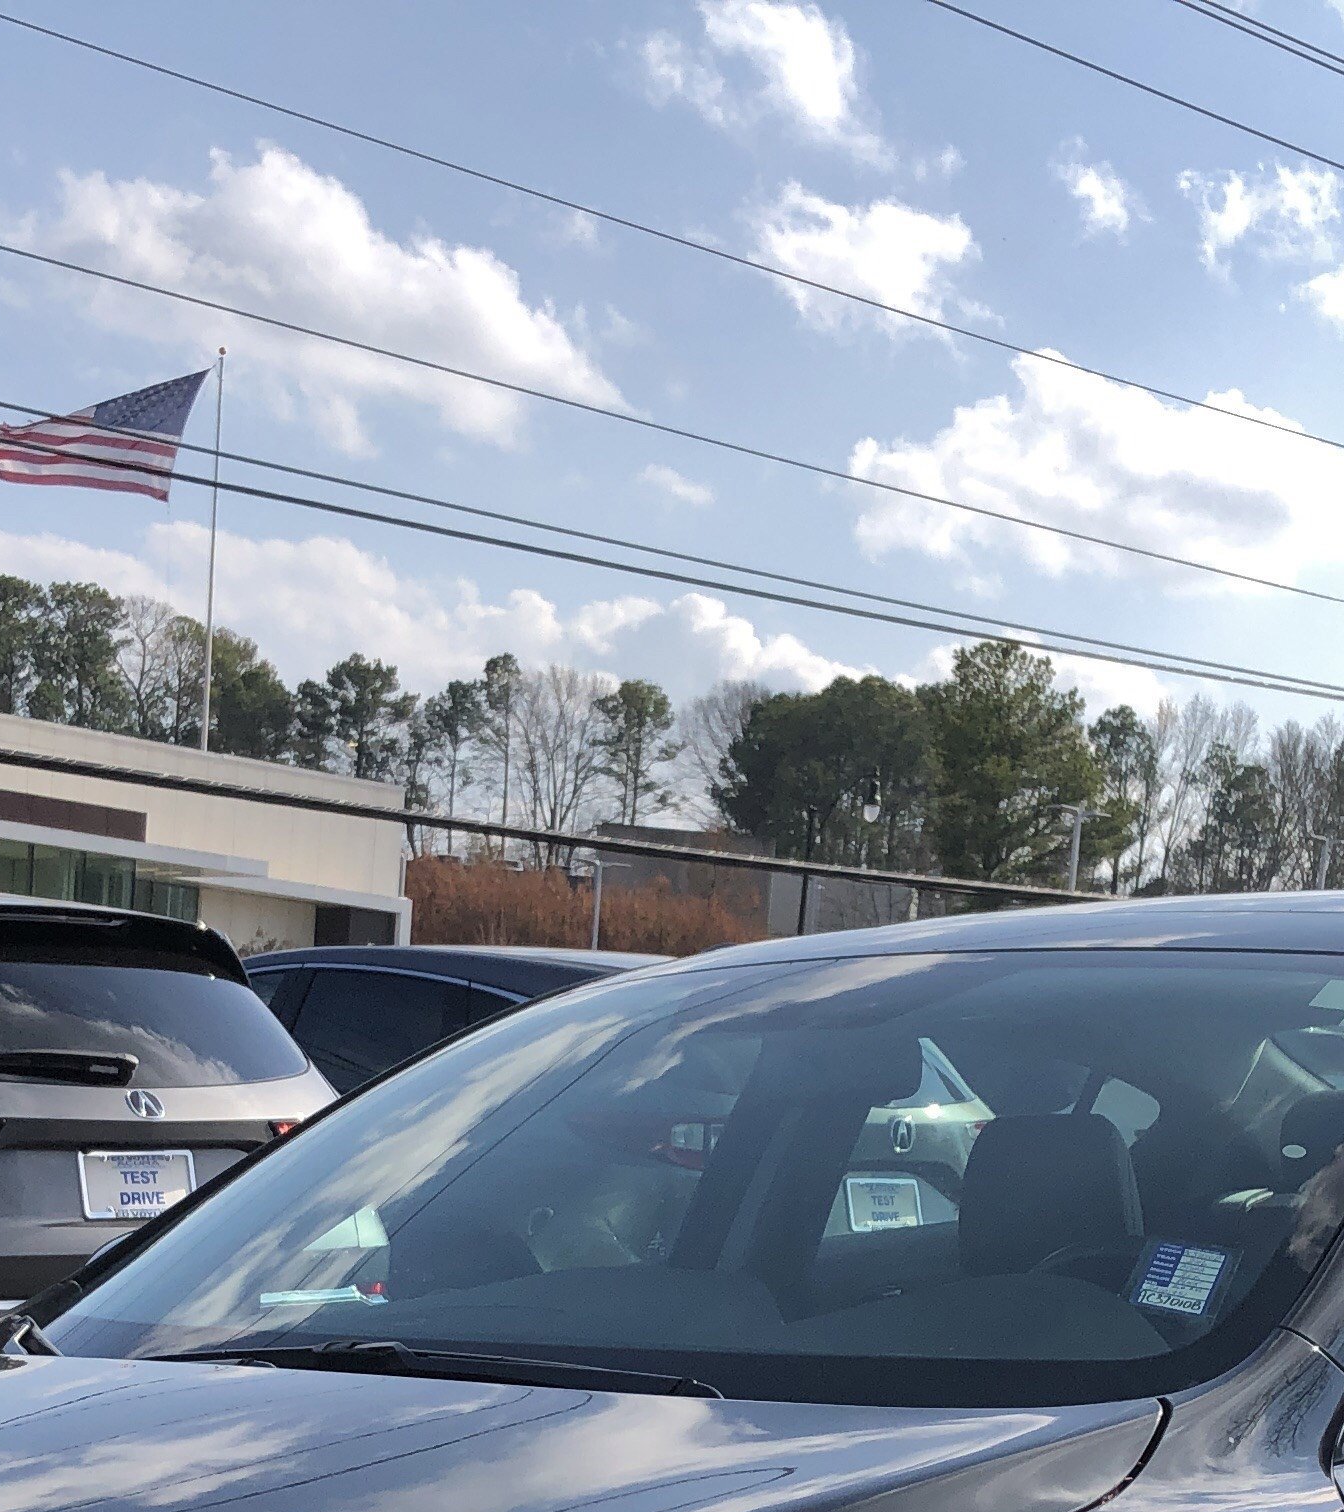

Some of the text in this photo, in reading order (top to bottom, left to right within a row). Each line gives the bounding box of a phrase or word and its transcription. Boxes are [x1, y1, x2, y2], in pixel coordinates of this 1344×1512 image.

[120, 1171, 159, 1184] TEST
[120, 1191, 165, 1205] DRIVE
[871, 1195, 895, 1206] TEST
